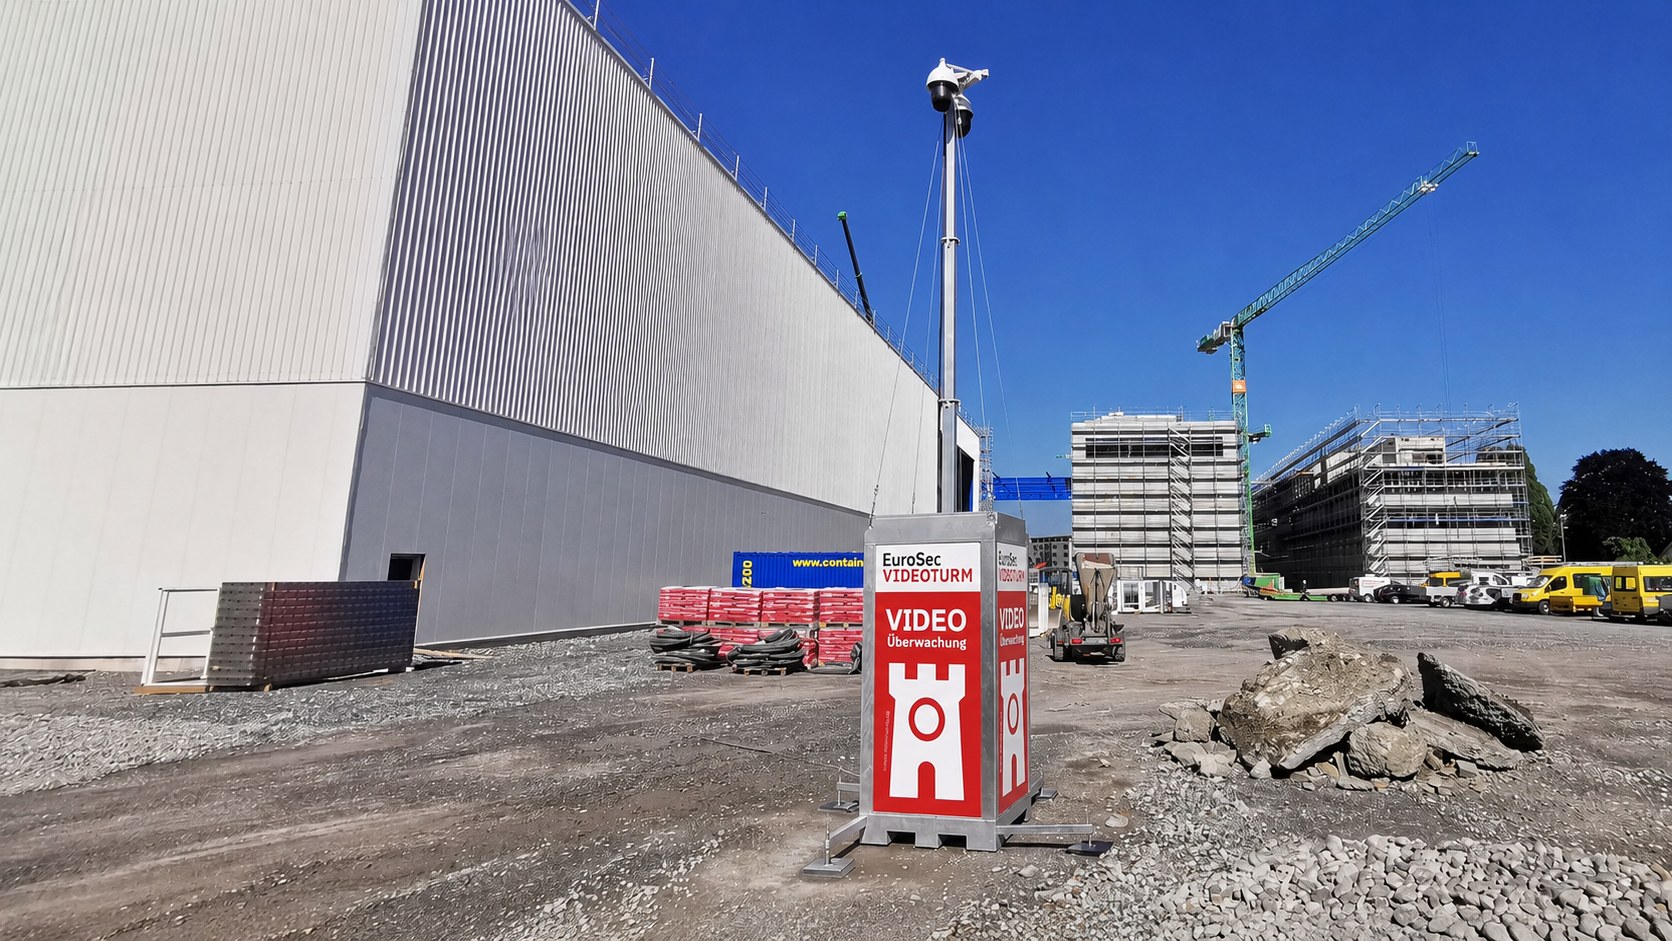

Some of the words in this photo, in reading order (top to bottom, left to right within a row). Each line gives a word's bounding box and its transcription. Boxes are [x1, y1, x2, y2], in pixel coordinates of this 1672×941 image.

[882, 552, 941, 567] EuroSec
[882, 568, 973, 582] VIDEOTURM
[885, 608, 967, 632] VIDEO
[999, 607, 1024, 631] VIDEO
[887, 633, 967, 651] Überwachung
